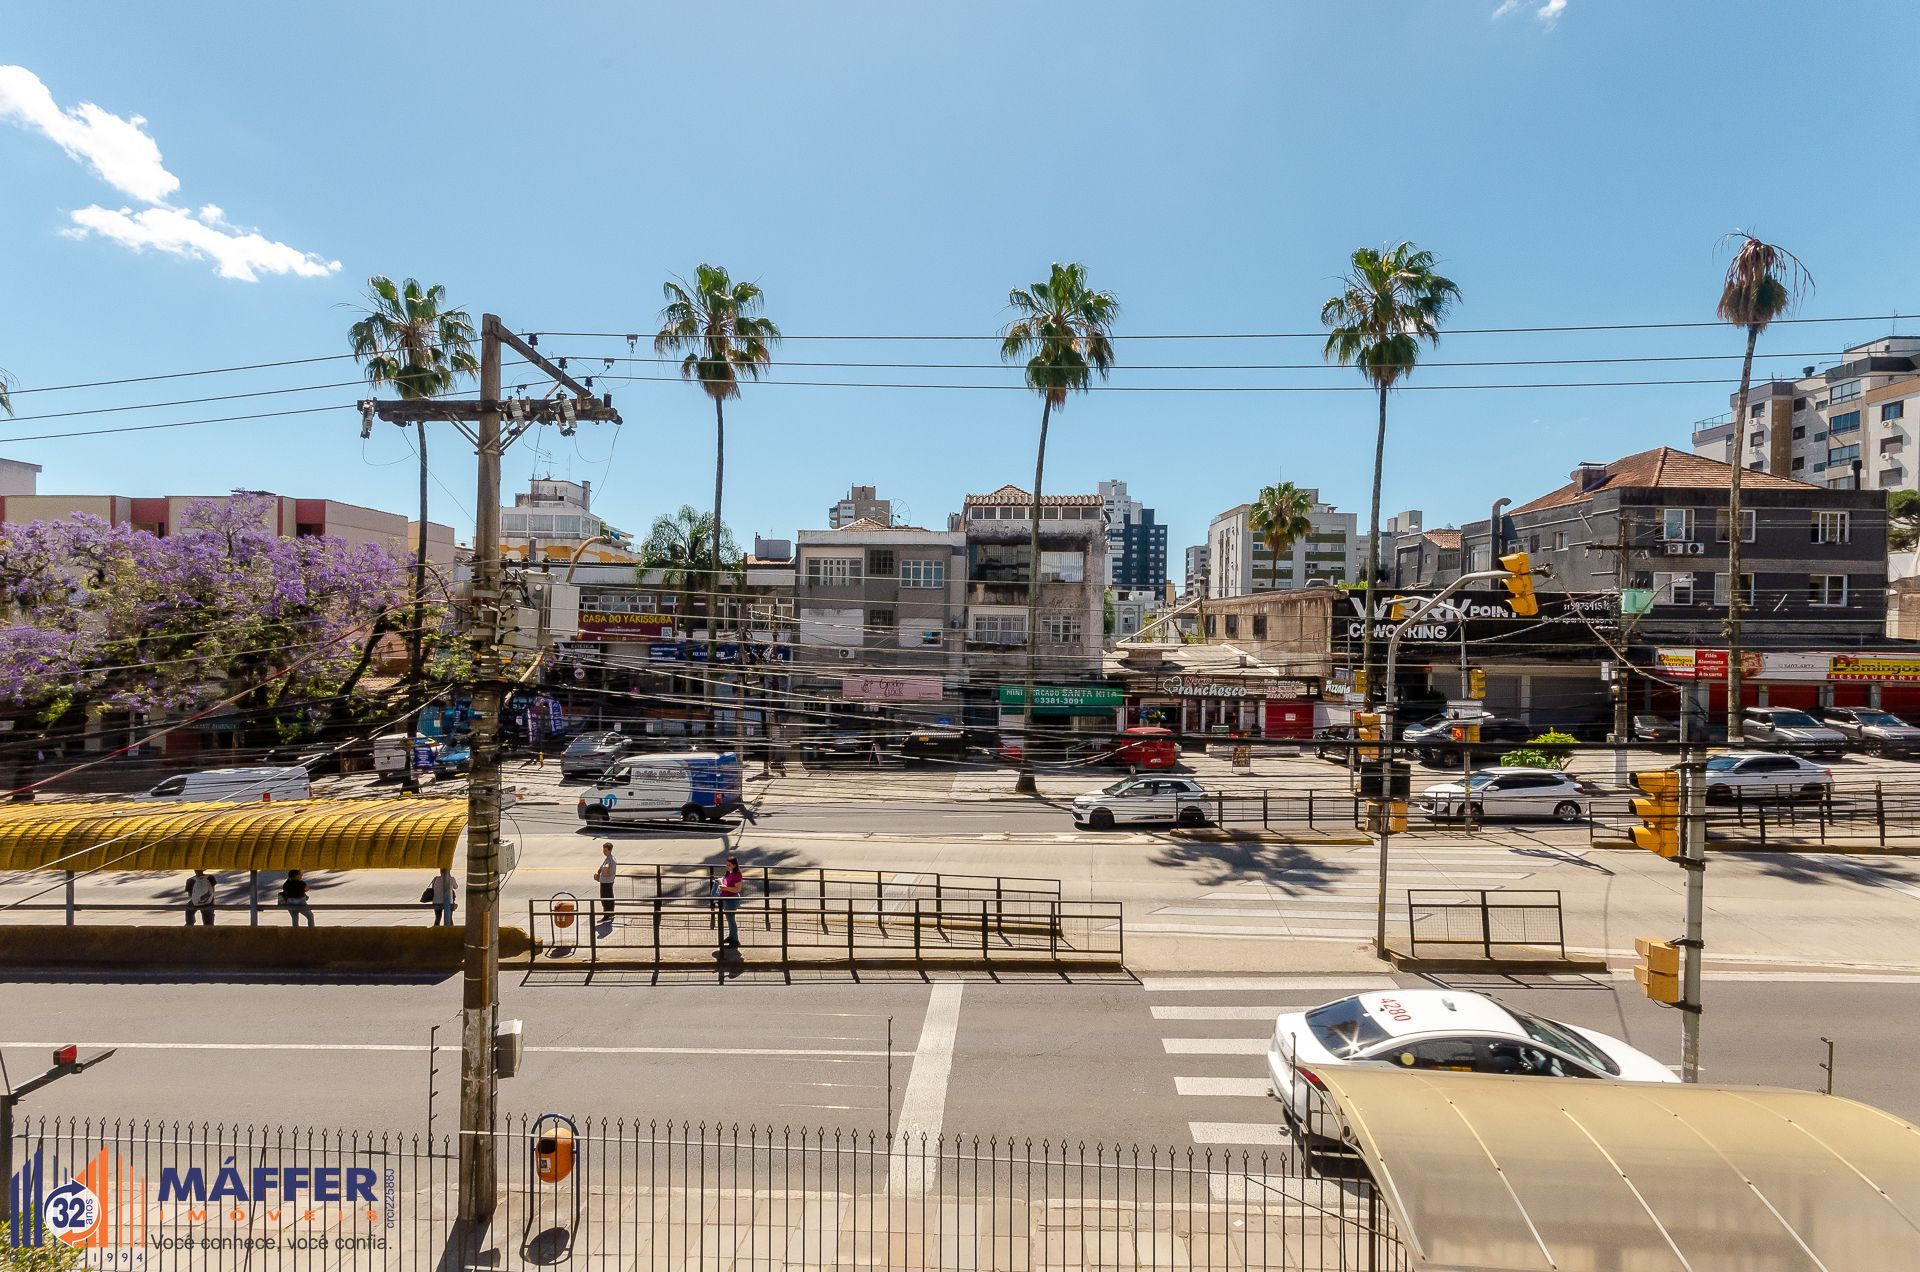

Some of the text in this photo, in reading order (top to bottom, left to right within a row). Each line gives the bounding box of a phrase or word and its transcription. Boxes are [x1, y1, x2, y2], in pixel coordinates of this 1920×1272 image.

[583, 614, 606, 623] CASA
[608, 614, 621, 623] DO
[1470, 606, 1517, 618] POIN
[1349, 622, 1447, 639] CWOKING
[1833, 656, 1920, 674] Domingos
[1006, 688, 1023, 696] MINI
[1062, 688, 1093, 697] SANTA
[1380, 998, 1412, 1021] 4280
